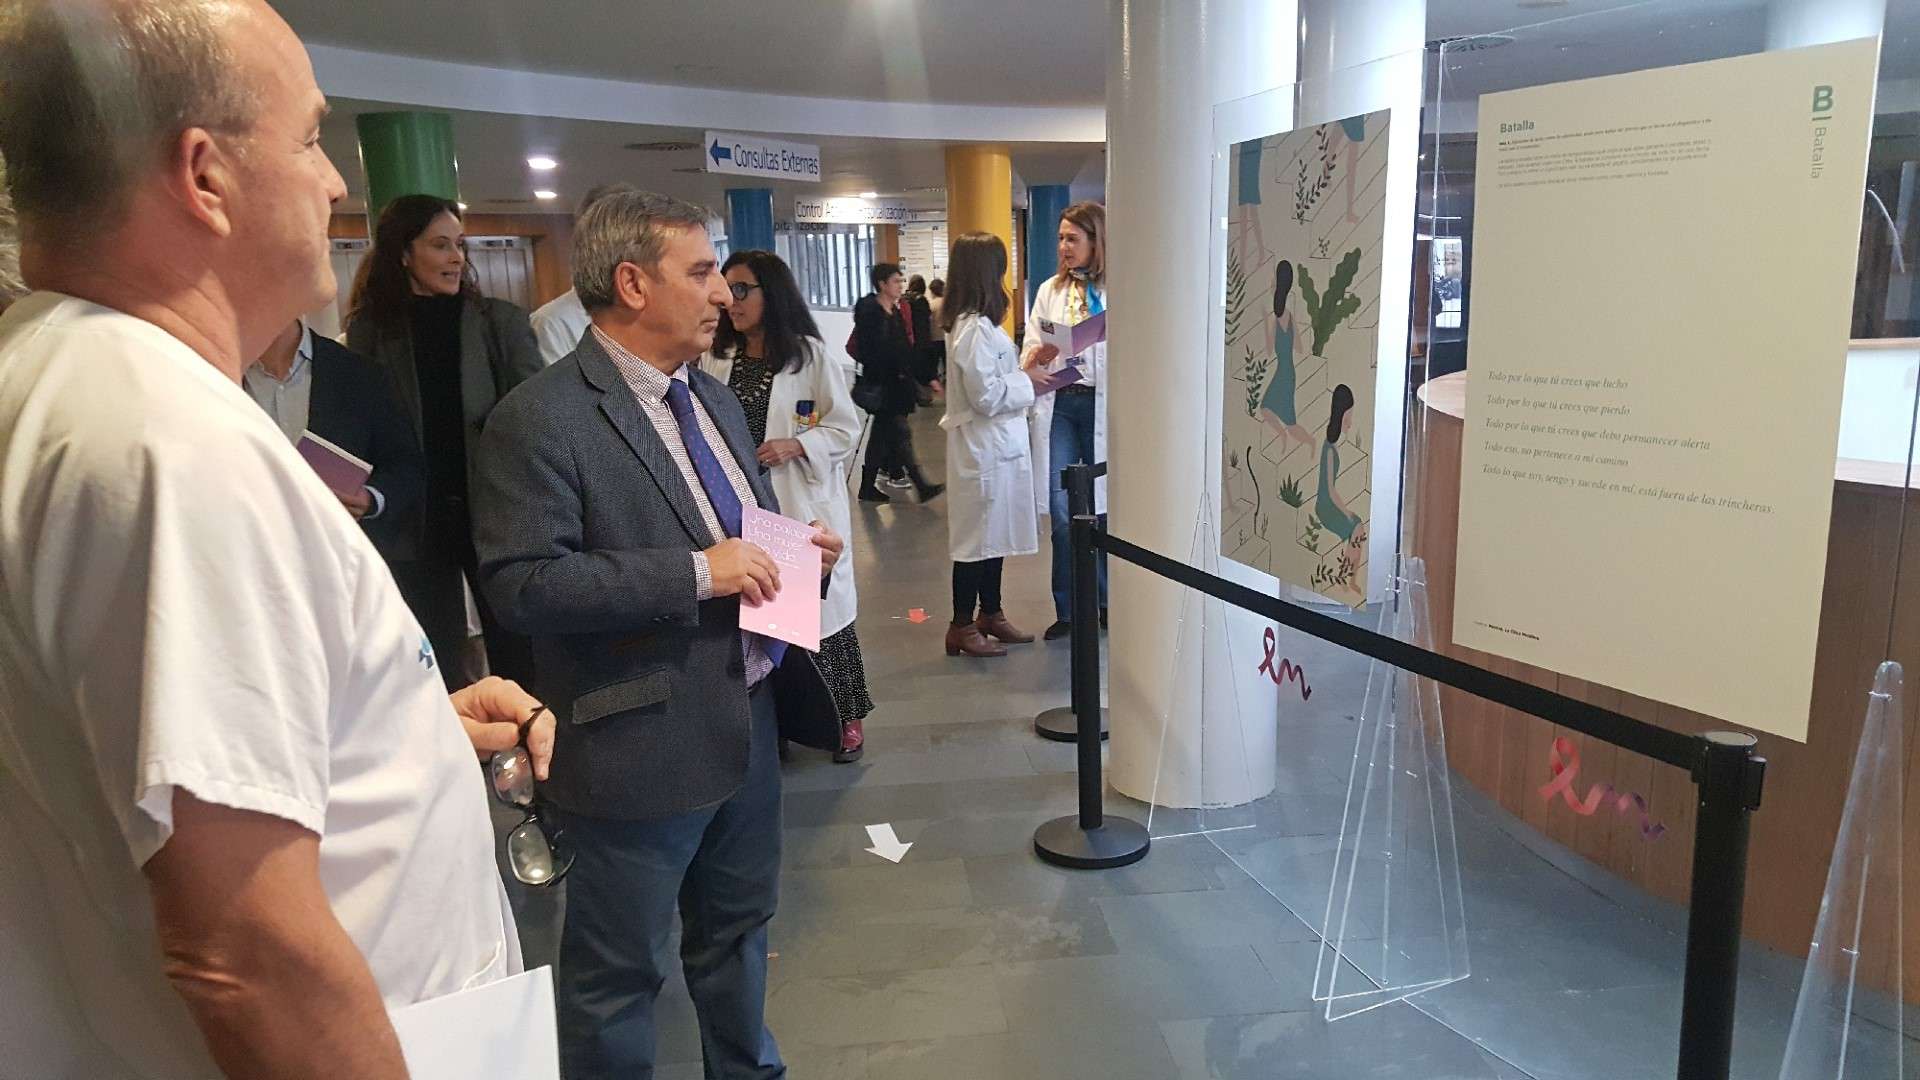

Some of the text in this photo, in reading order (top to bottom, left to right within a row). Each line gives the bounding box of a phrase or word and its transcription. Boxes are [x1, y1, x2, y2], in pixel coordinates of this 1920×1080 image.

[1812, 85, 1833, 112] B
[1500, 119, 1535, 133] Batalla
[734, 143, 818, 175] Consultas Externas
[1811, 127, 1827, 179] Batalla
